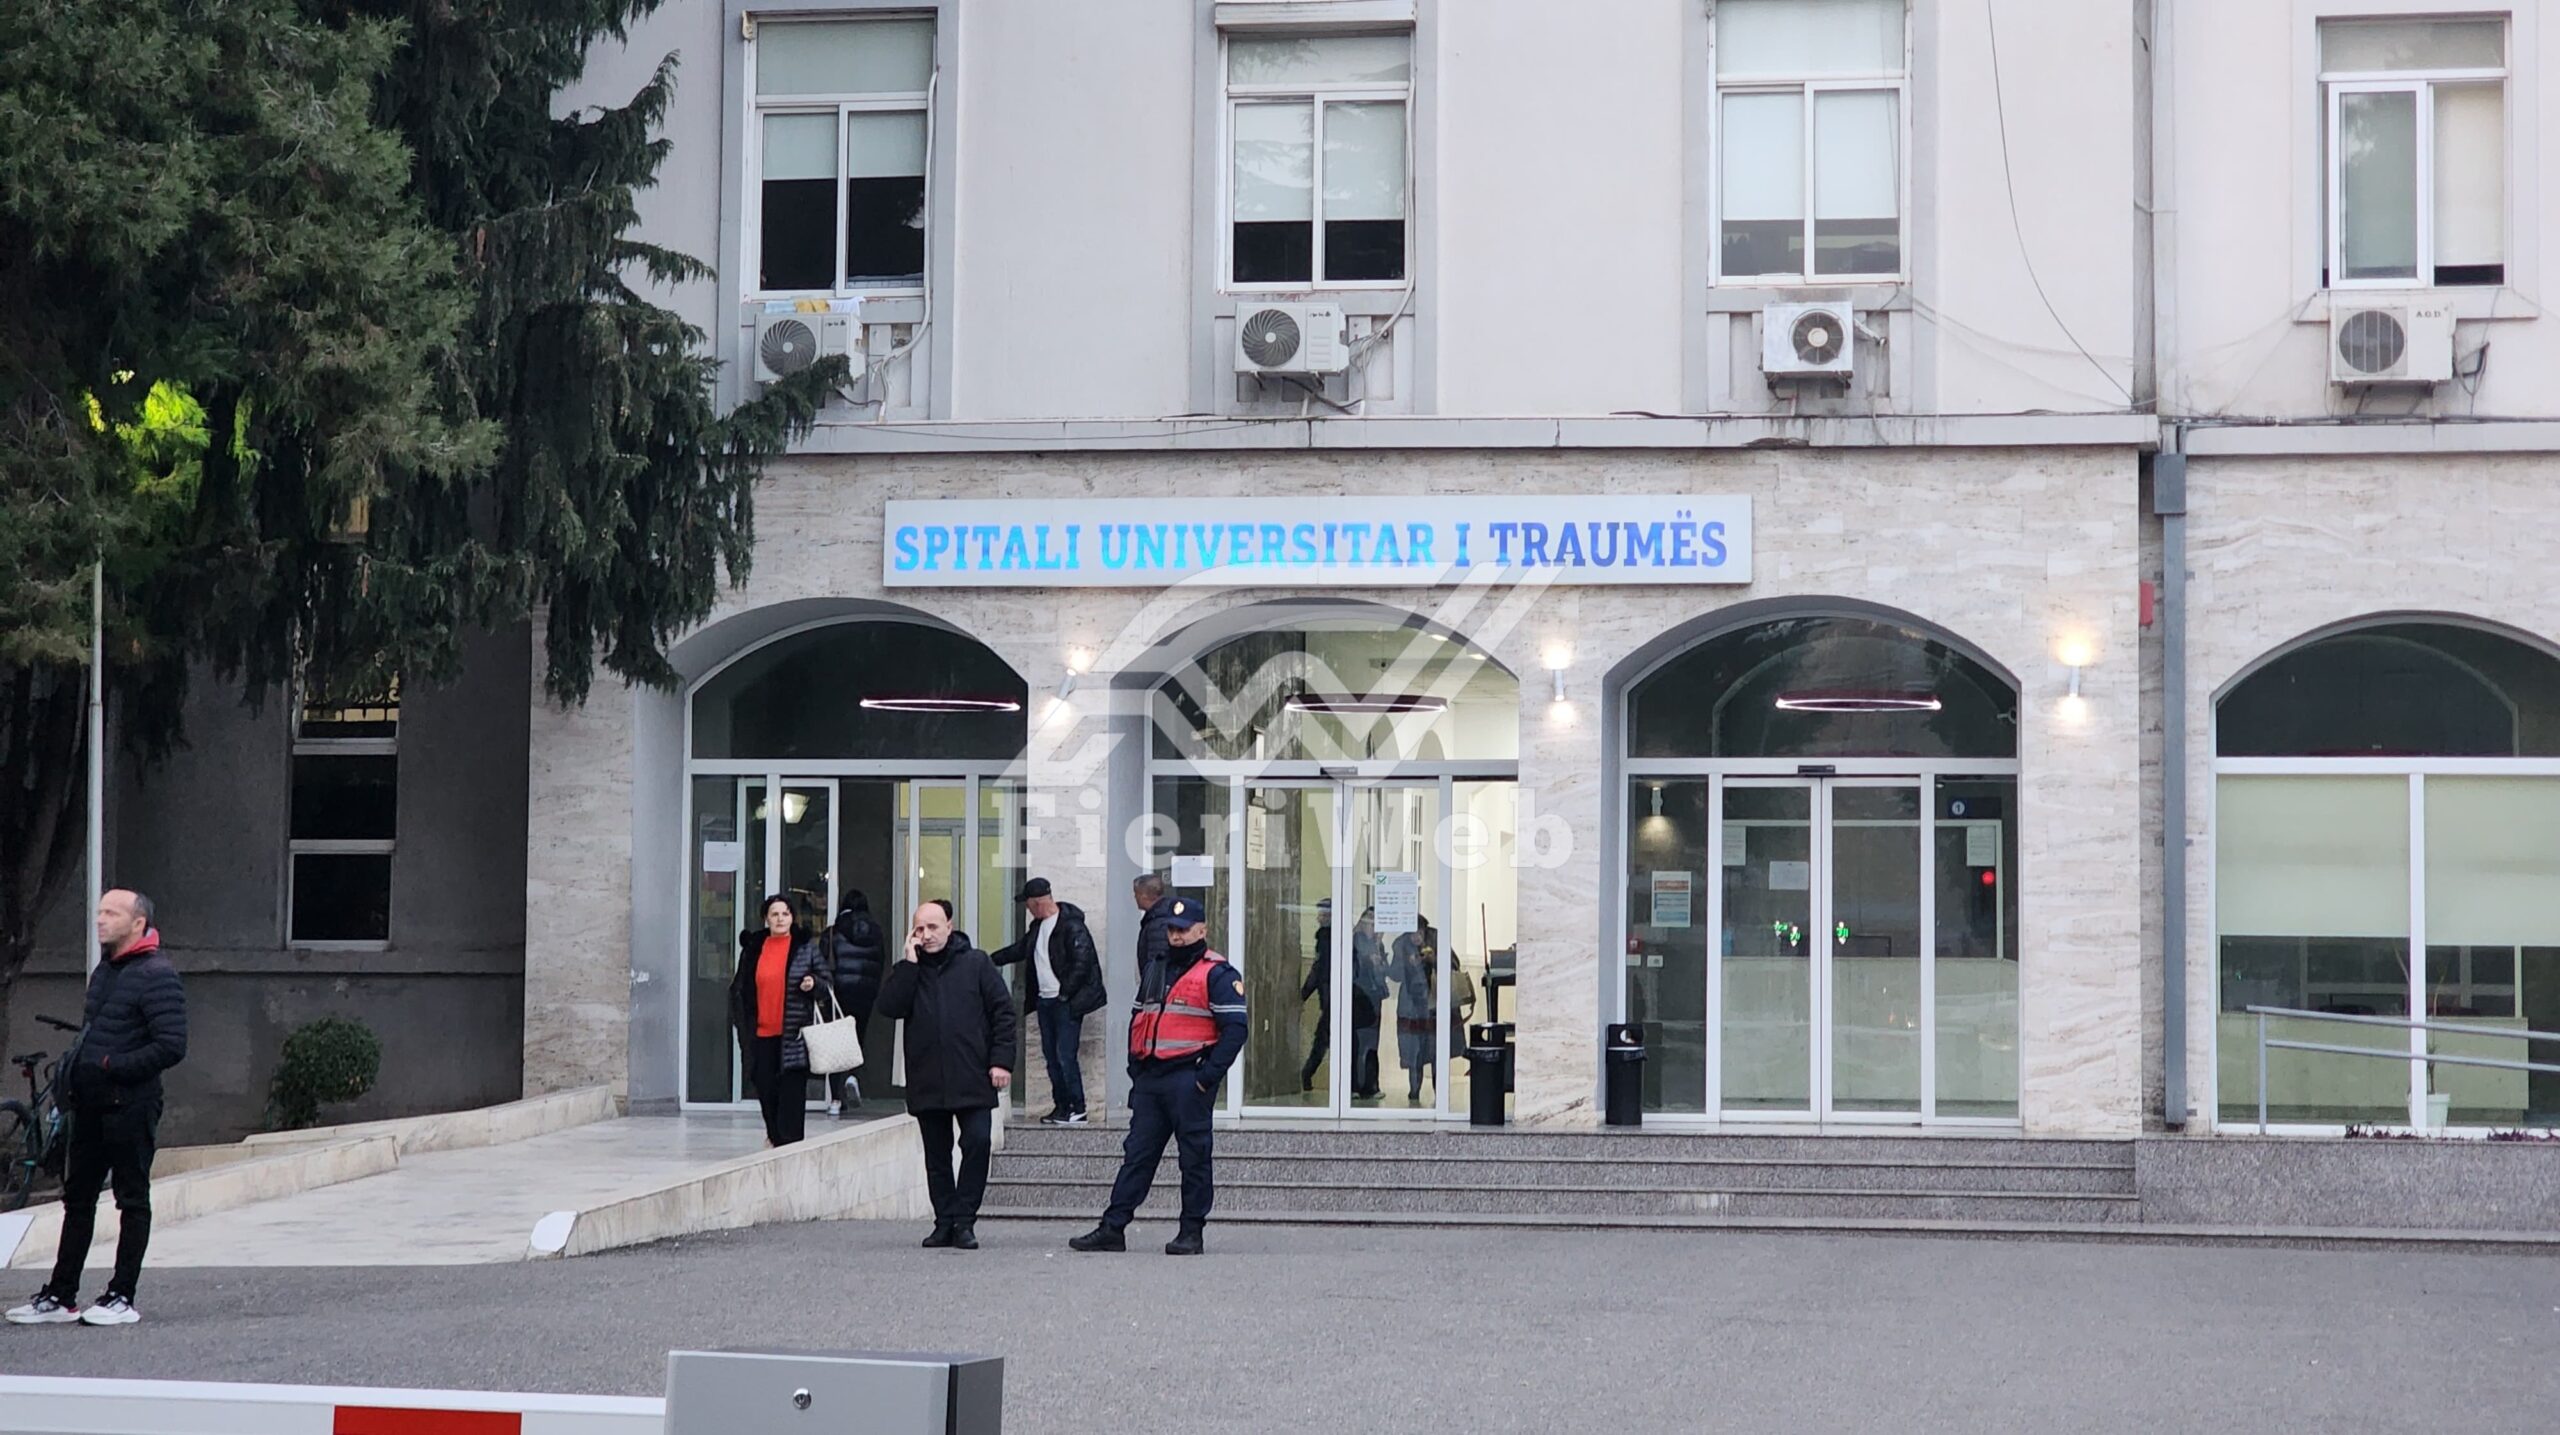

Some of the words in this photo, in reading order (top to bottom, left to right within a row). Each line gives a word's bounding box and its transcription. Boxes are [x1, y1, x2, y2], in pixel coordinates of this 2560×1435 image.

[894, 524, 1081, 571] SPITALI
[1099, 522, 1436, 569] UNIVERSITAR
[1455, 522, 1471, 567] I
[1488, 509, 1727, 567] TRAUMËS
